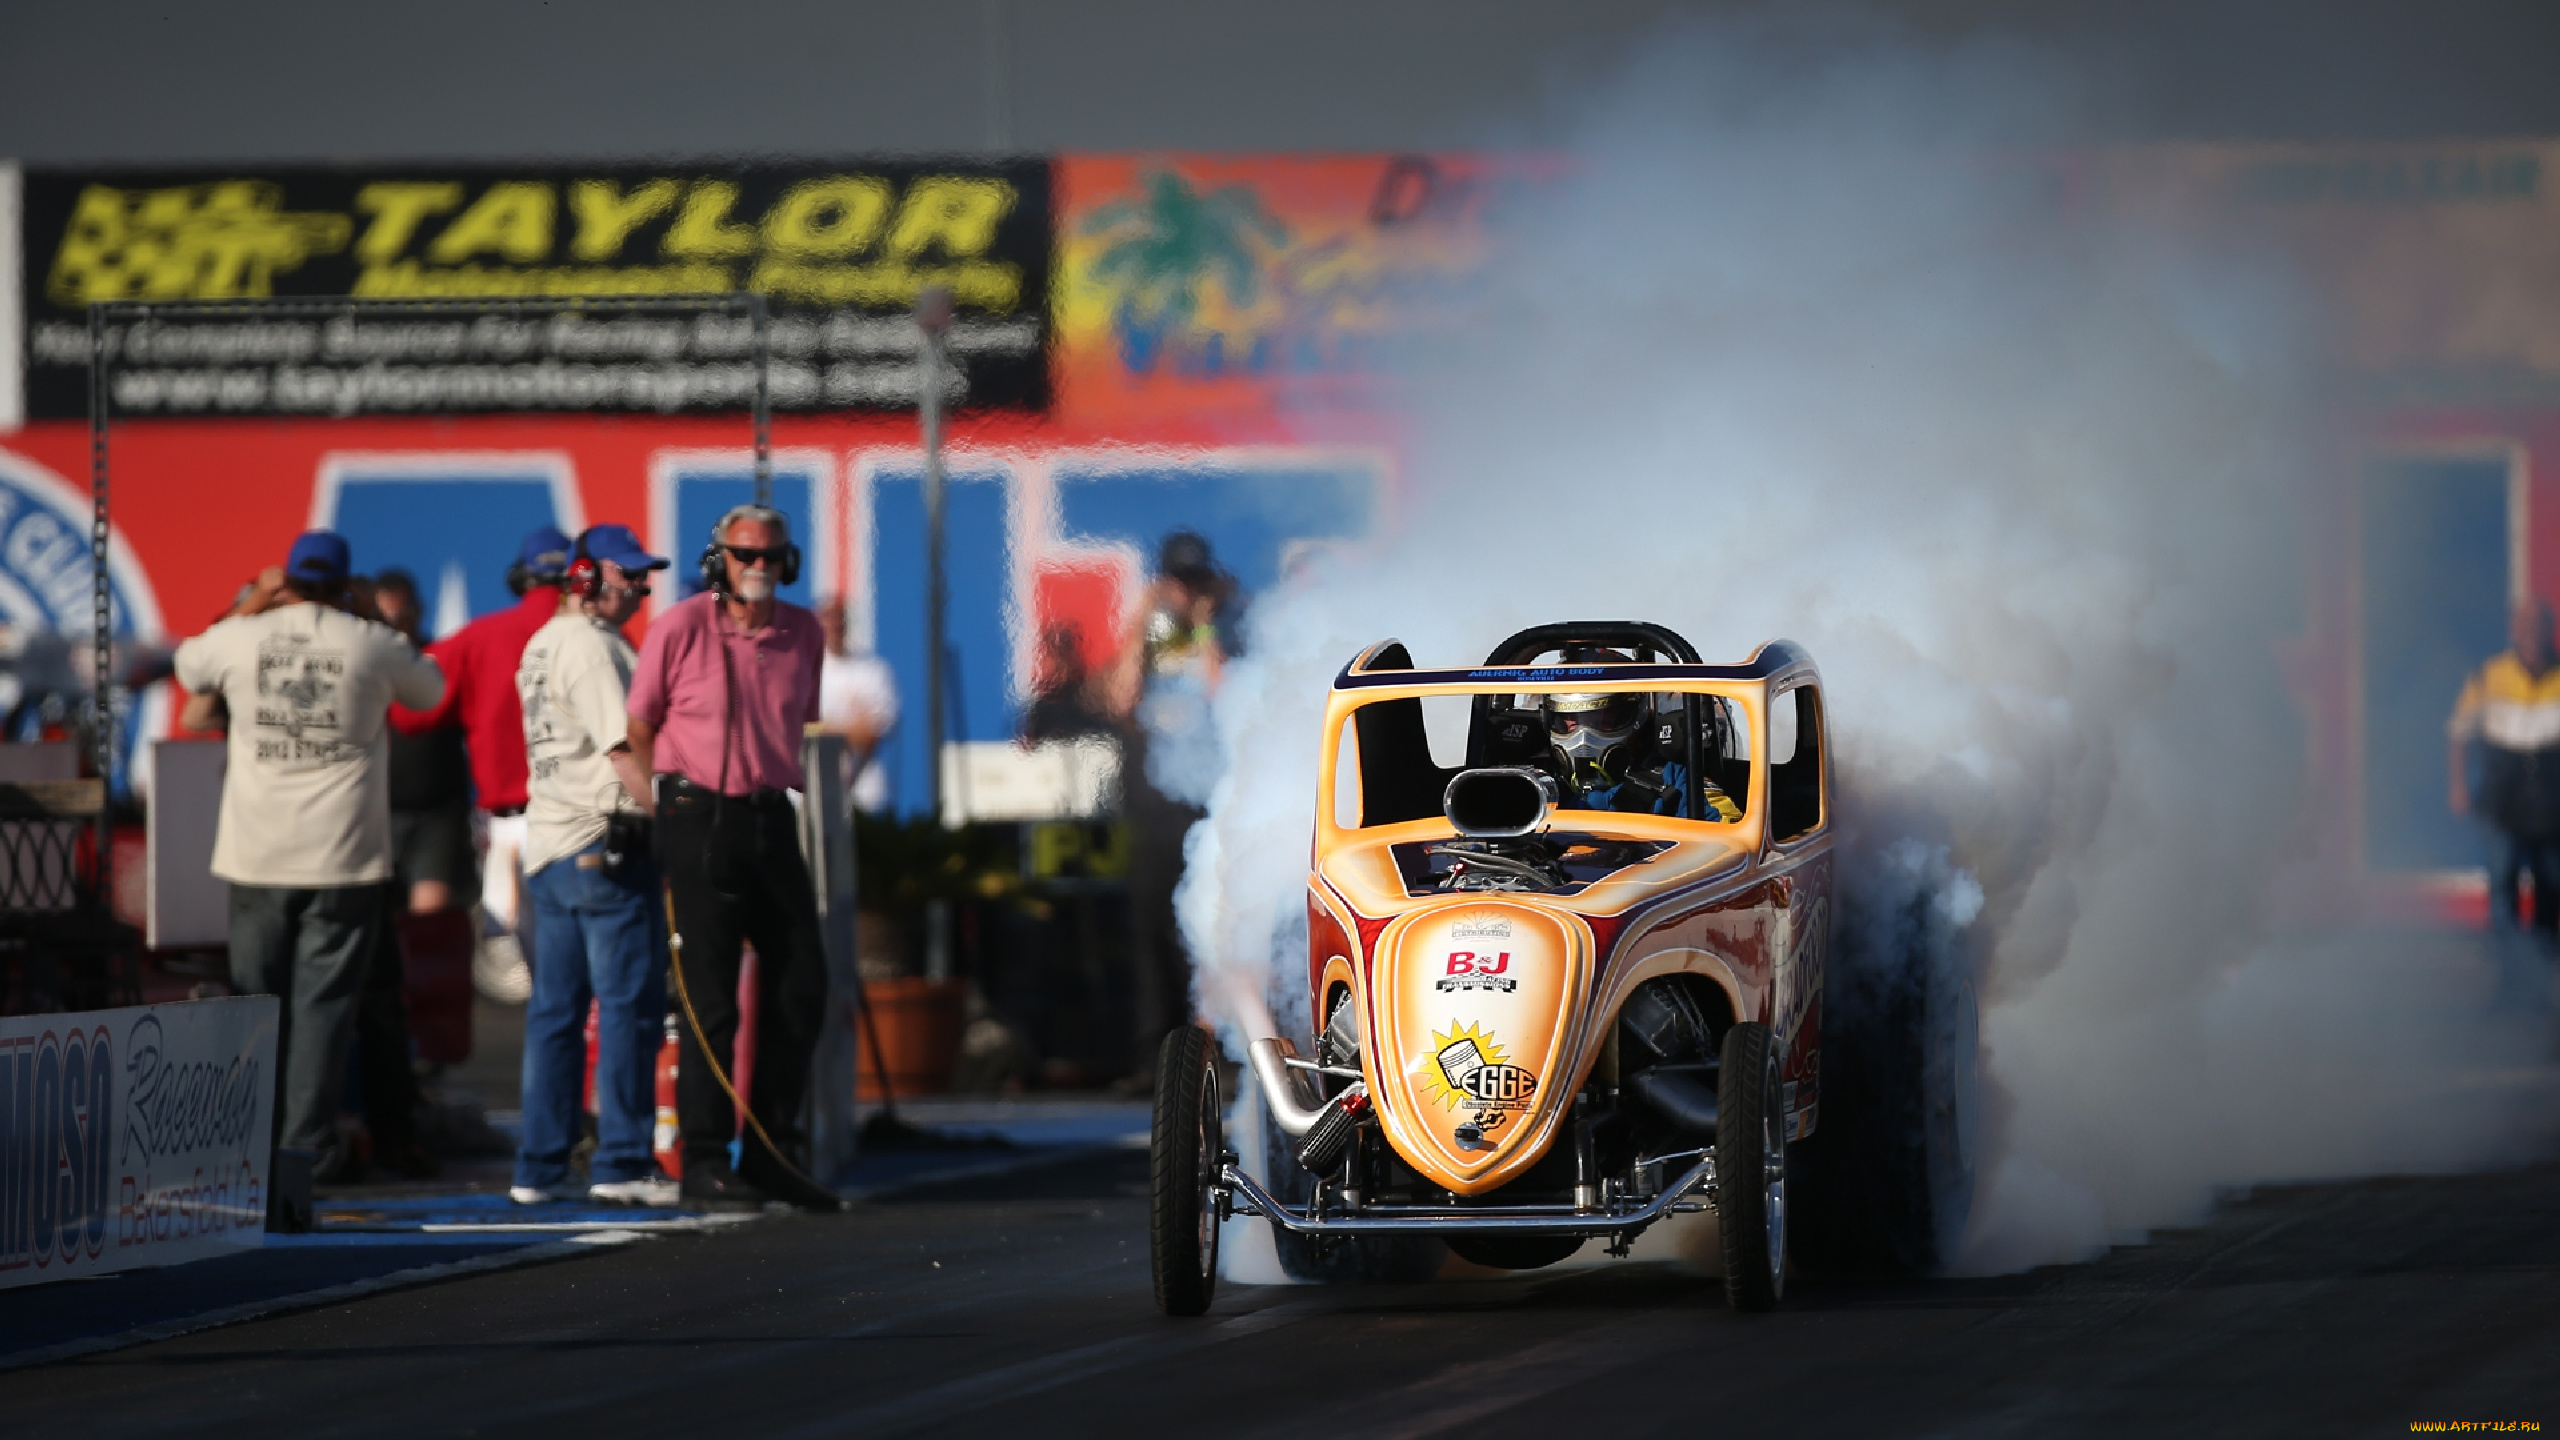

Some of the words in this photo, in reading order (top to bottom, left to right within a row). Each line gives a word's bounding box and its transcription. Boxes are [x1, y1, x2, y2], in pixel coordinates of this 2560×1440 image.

[354, 177, 1020, 257] TAYLOR
[1530, 668, 1565, 676] AUTO
[1568, 667, 1605, 675] BODY
[121, 1013, 259, 1182] Raceway
[1461, 1065, 1536, 1099] EGGE
